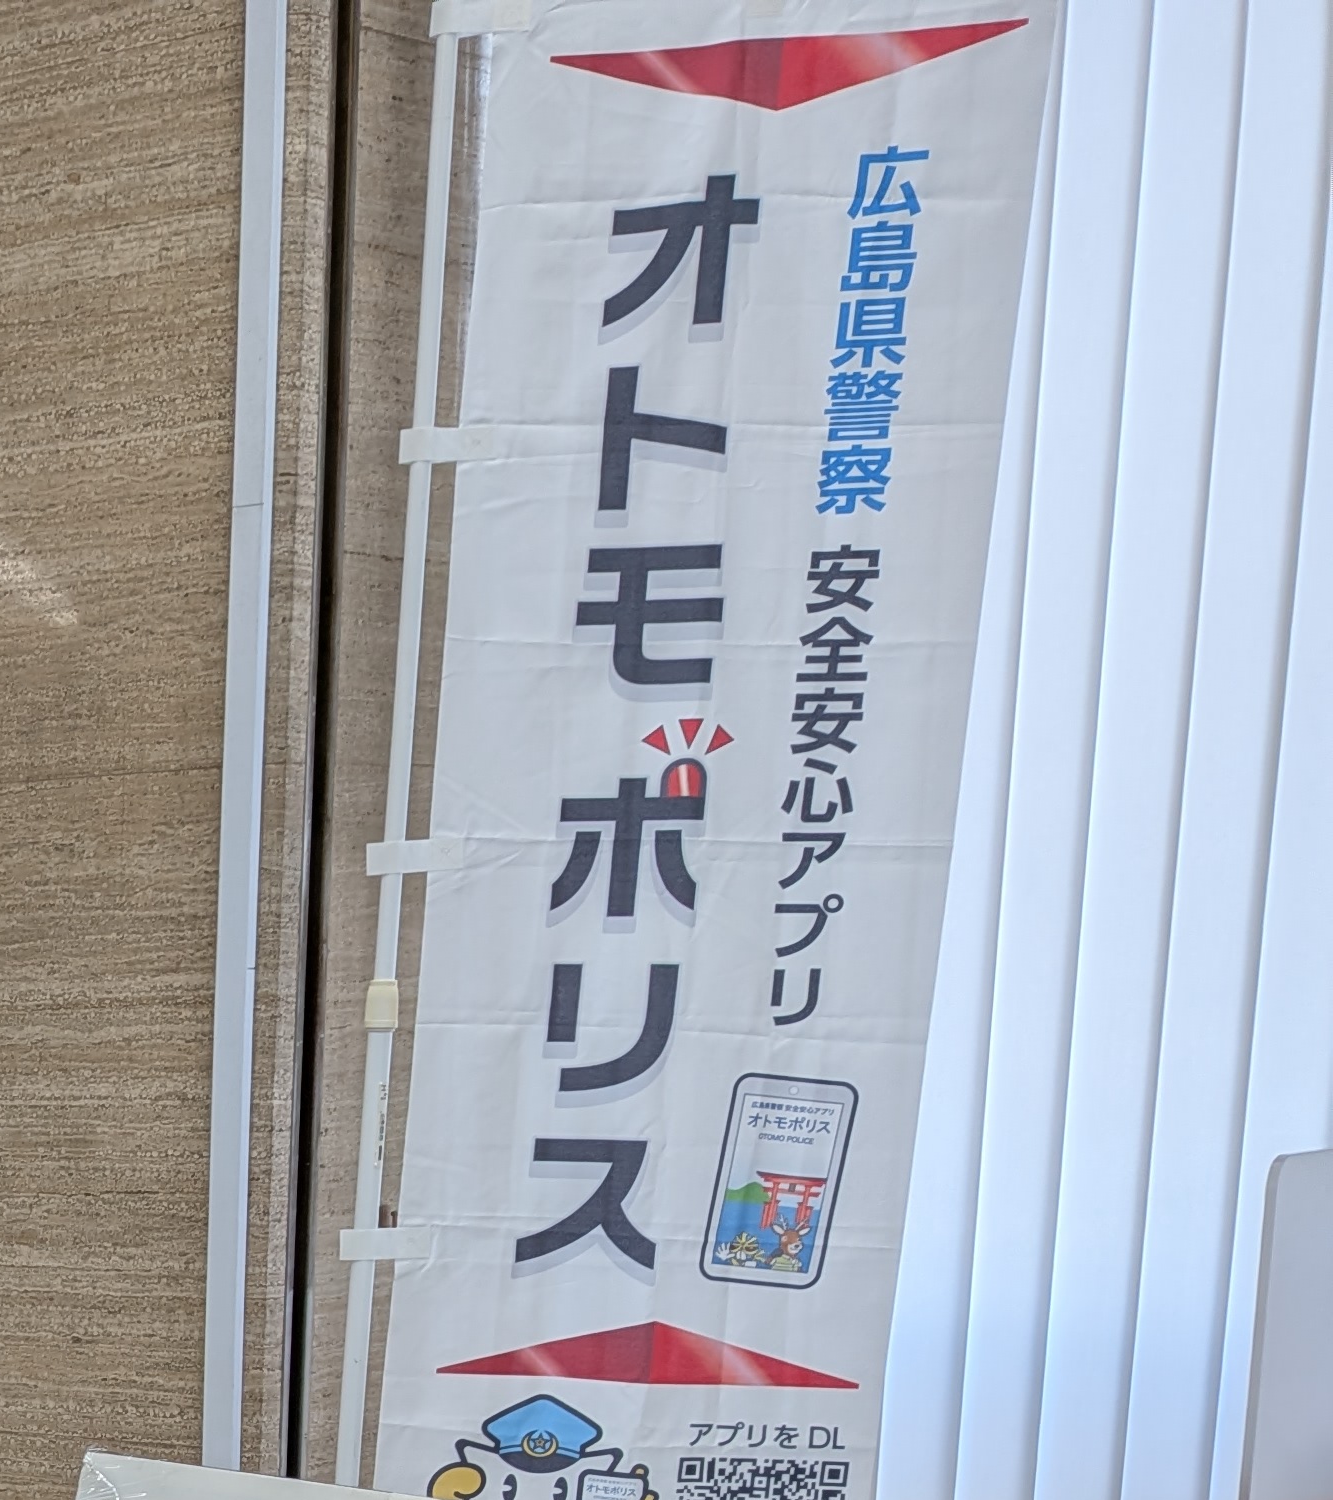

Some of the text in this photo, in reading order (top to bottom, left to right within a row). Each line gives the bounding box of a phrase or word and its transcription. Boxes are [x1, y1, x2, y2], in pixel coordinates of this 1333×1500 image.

[514, 172, 761, 1274] オトモポリス
[769, 145, 930, 1027] 広島県警察 安全安心アプリ
[747, 1112, 831, 1134] オトモポリス
[758, 1133, 814, 1145] OTOMO POLICE
